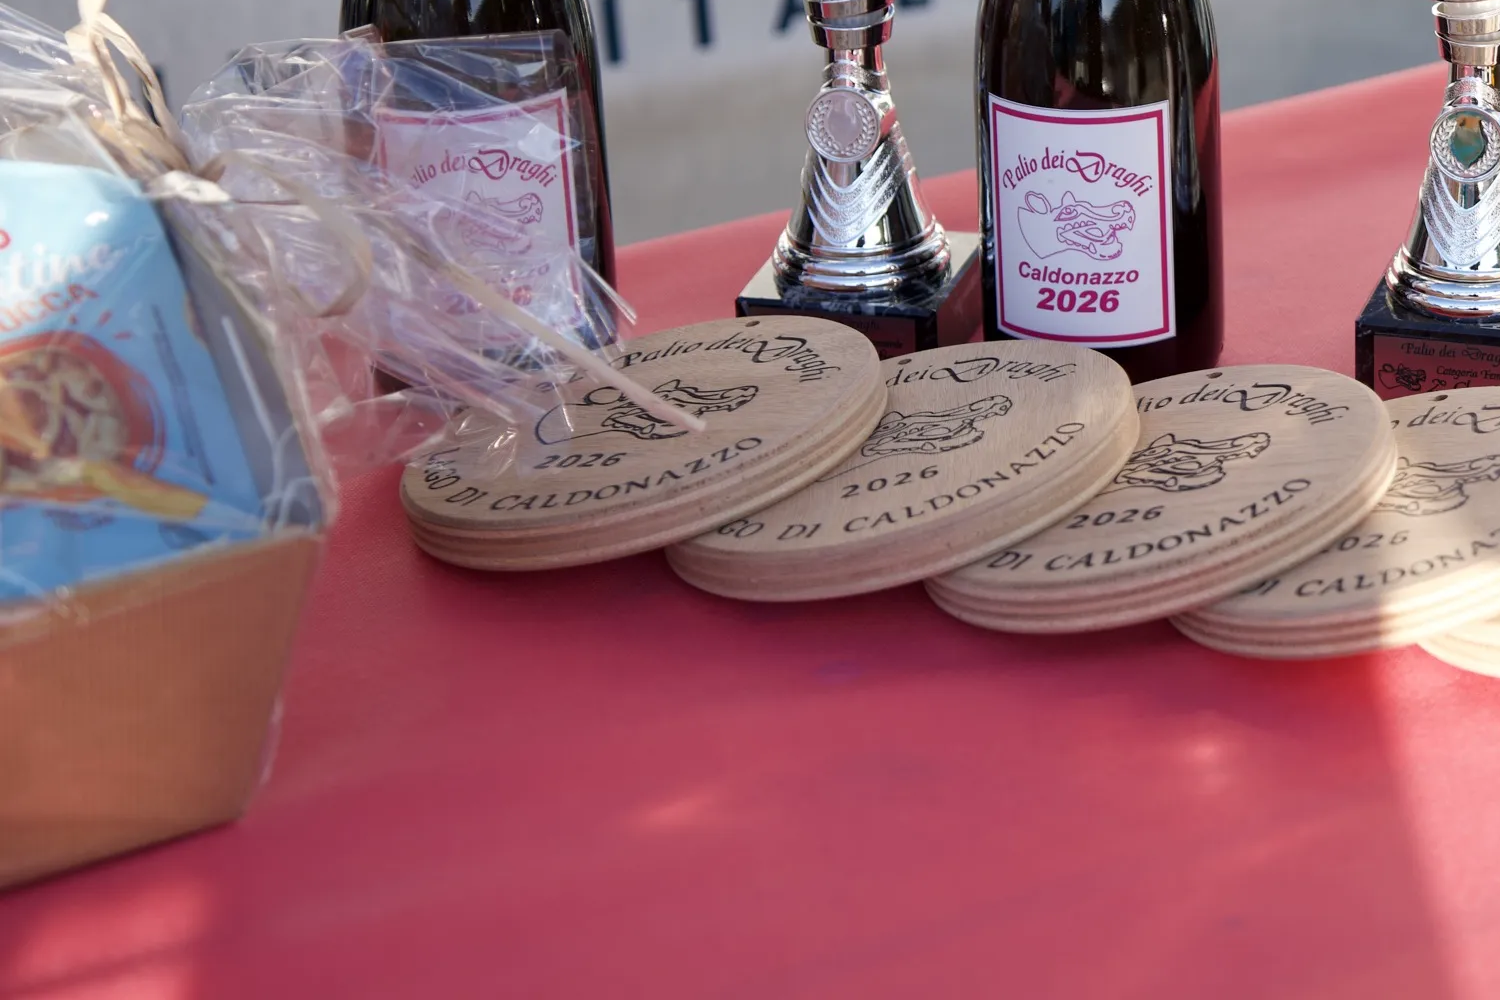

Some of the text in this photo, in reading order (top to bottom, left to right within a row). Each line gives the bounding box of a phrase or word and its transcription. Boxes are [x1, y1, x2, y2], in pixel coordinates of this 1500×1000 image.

[467, 149, 558, 188] Draghi
[1002, 147, 1153, 197] Palio dei Draghi
[1018, 260, 1140, 285] Caldonazzo
[1036, 287, 1121, 313] 2026
[607, 331, 840, 383] Palio dei Draghi
[1400, 341, 1436, 358] Palio
[1438, 343, 1456, 358] dei
[888, 356, 1077, 387] dei Draghi
[1436, 365, 1478, 382] Categoria
[1136, 382, 1349, 426] lio dei Draghi
[1407, 401, 1459, 429] dei
[446, 487, 488, 507] DI
[490, 436, 763, 512] CALDONAZZO
[534, 451, 627, 470] 2026
[717, 421, 1086, 541] GO DI CALDONAZZO
[841, 465, 940, 499] 2026
[986, 476, 1312, 572] DI CALDONAZZO
[1065, 505, 1166, 530] 2026
[1320, 530, 1409, 553] 026
